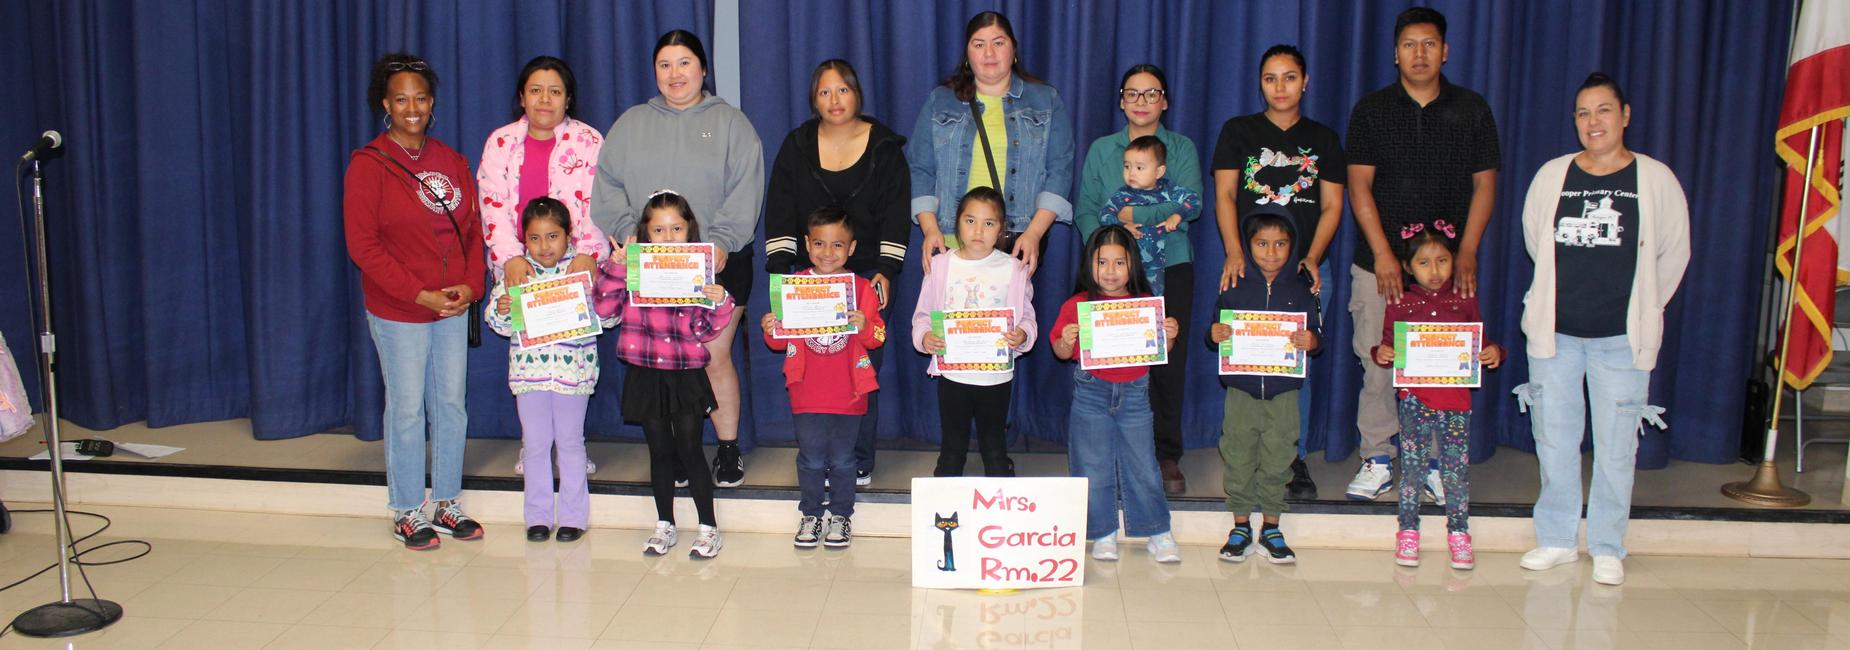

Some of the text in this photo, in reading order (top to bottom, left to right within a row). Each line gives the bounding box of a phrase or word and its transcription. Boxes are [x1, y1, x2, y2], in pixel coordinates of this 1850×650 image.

[1560, 190, 1582, 198] ooper
[1583, 189, 1613, 198] Primary
[643, 262, 699, 270] ATTENDANCE
[786, 291, 840, 300] ATTENDANCE
[1094, 316, 1150, 327] ATTENDANCE
[948, 326, 1001, 335] ATTENDANCE
[972, 488, 1037, 513] Mrs.
[978, 525, 1077, 549] Garcia
[980, 557, 1079, 583] Rm.22
